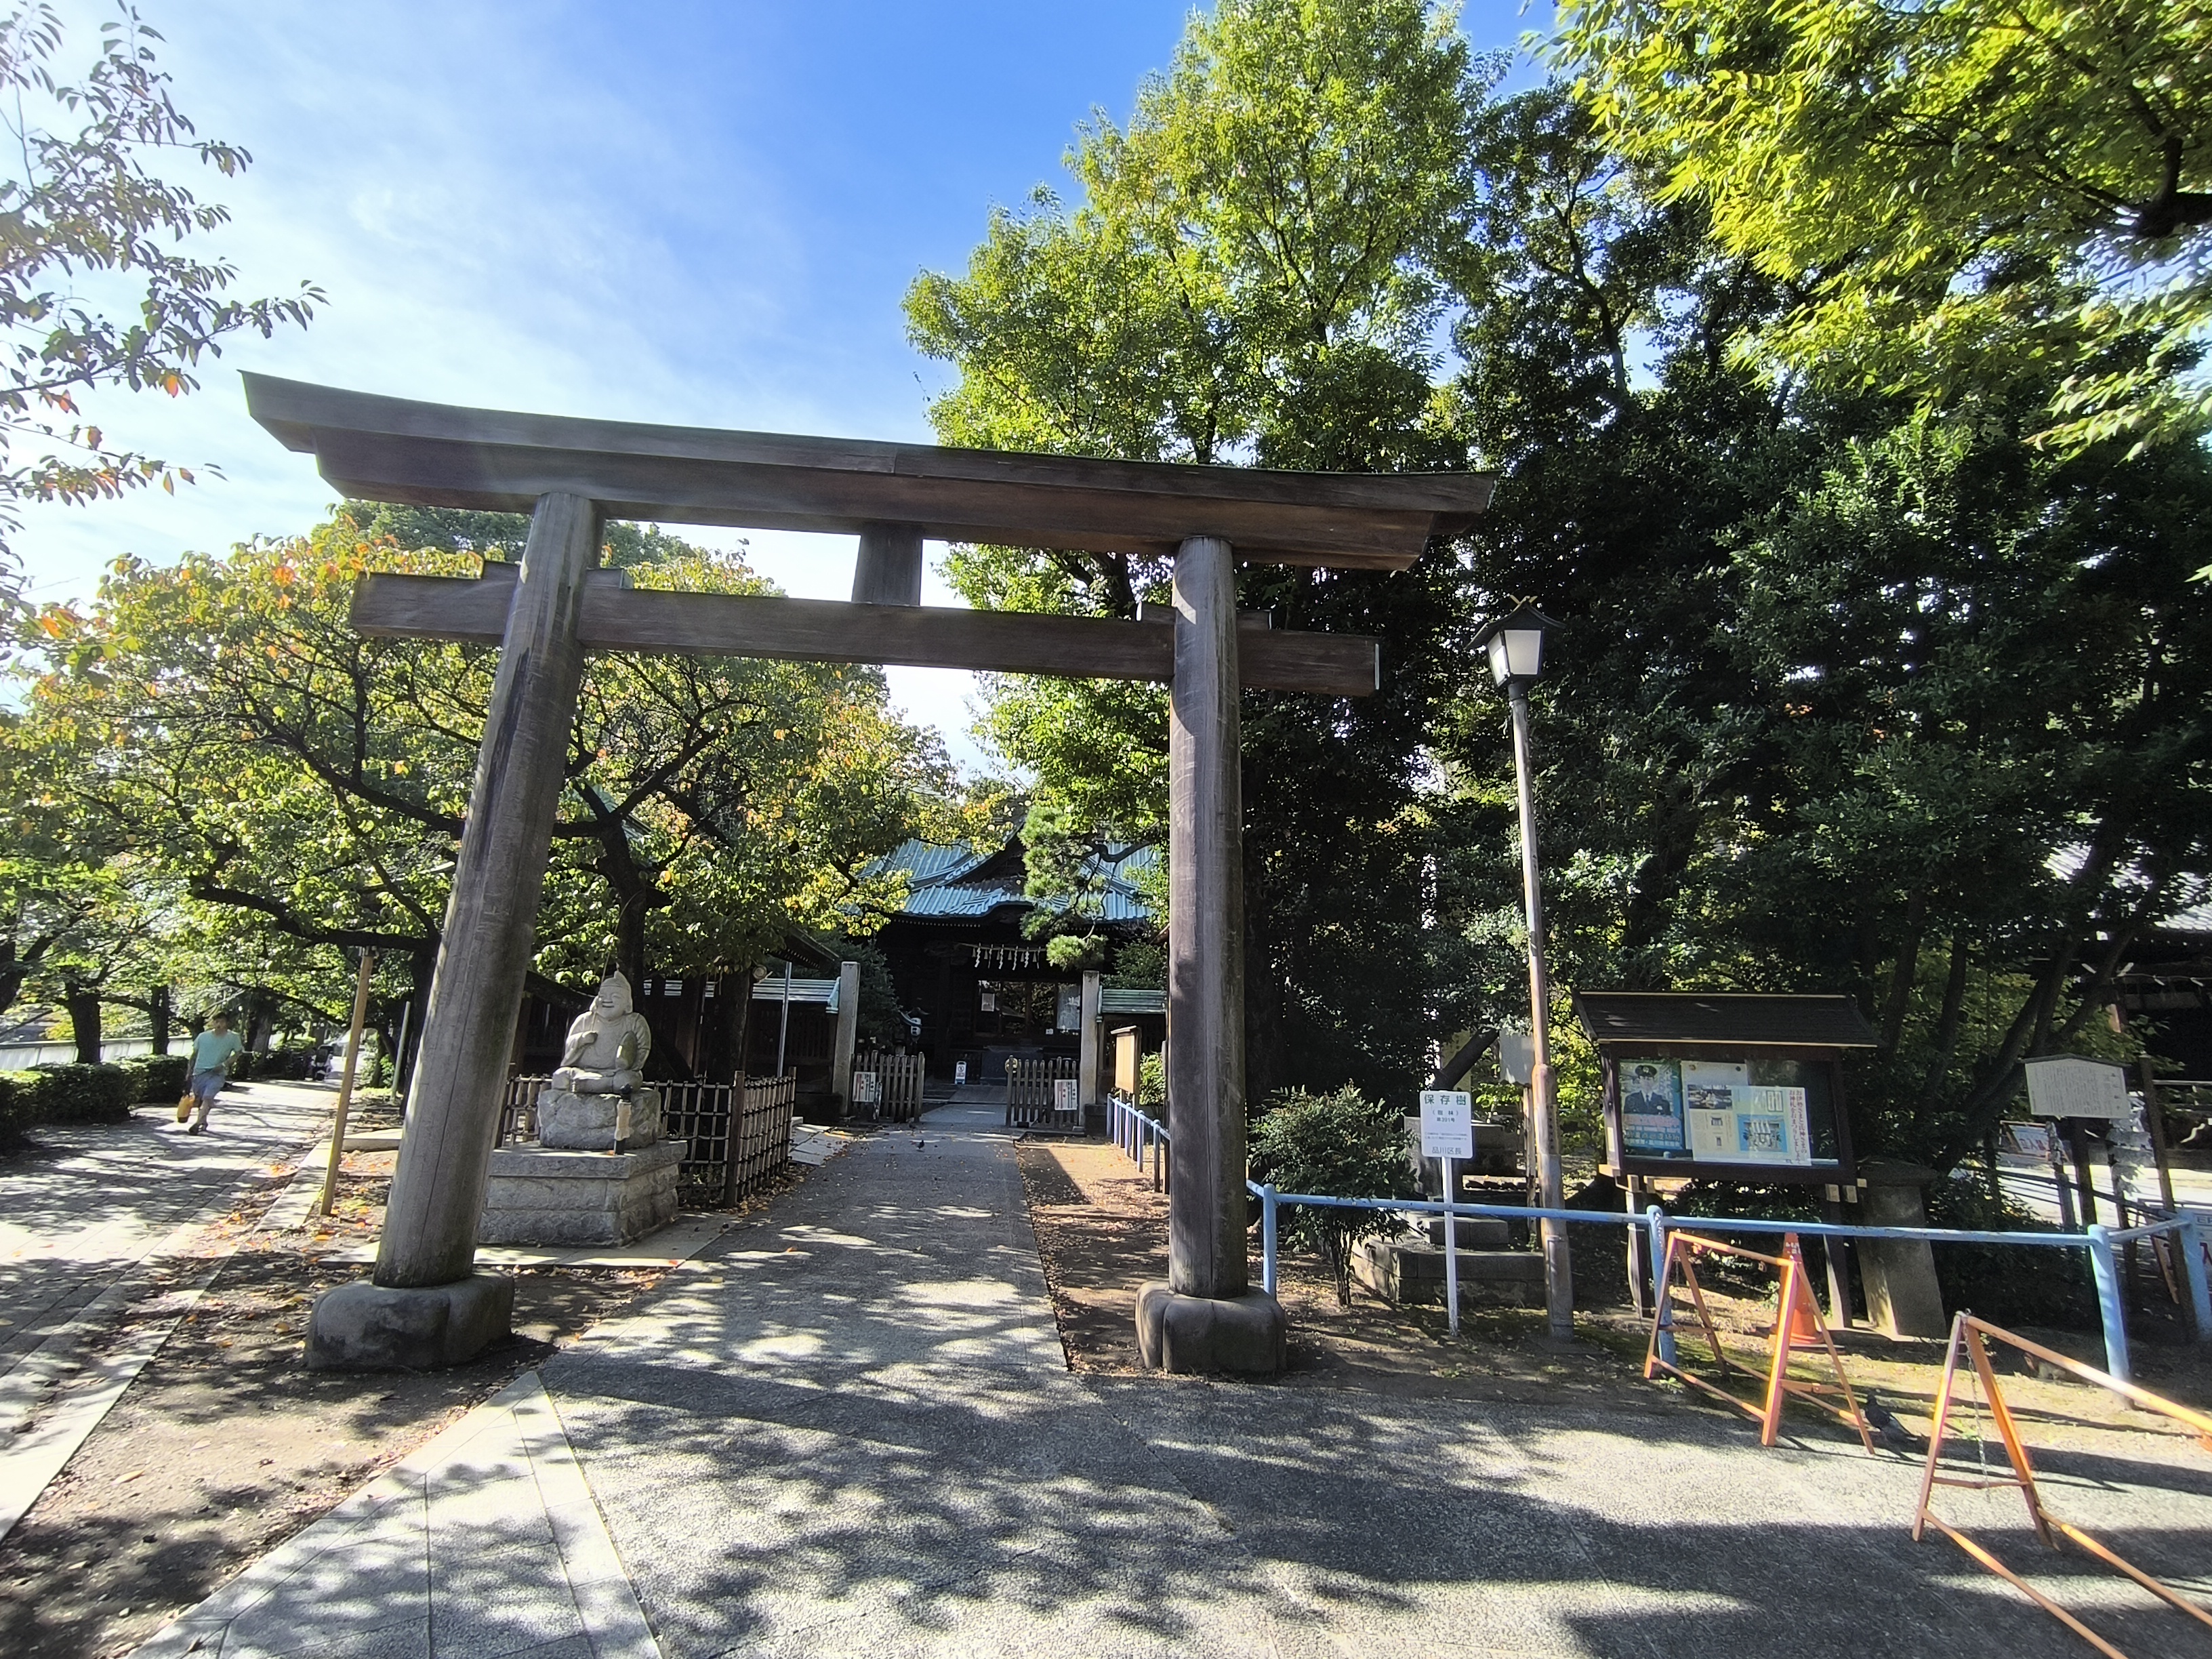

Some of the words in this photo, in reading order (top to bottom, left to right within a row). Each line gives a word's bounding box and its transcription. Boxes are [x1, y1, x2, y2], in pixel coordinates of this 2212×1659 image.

[1424, 1094, 1467, 1106] 保存樹
[1431, 1146, 1462, 1155] 品川区長
